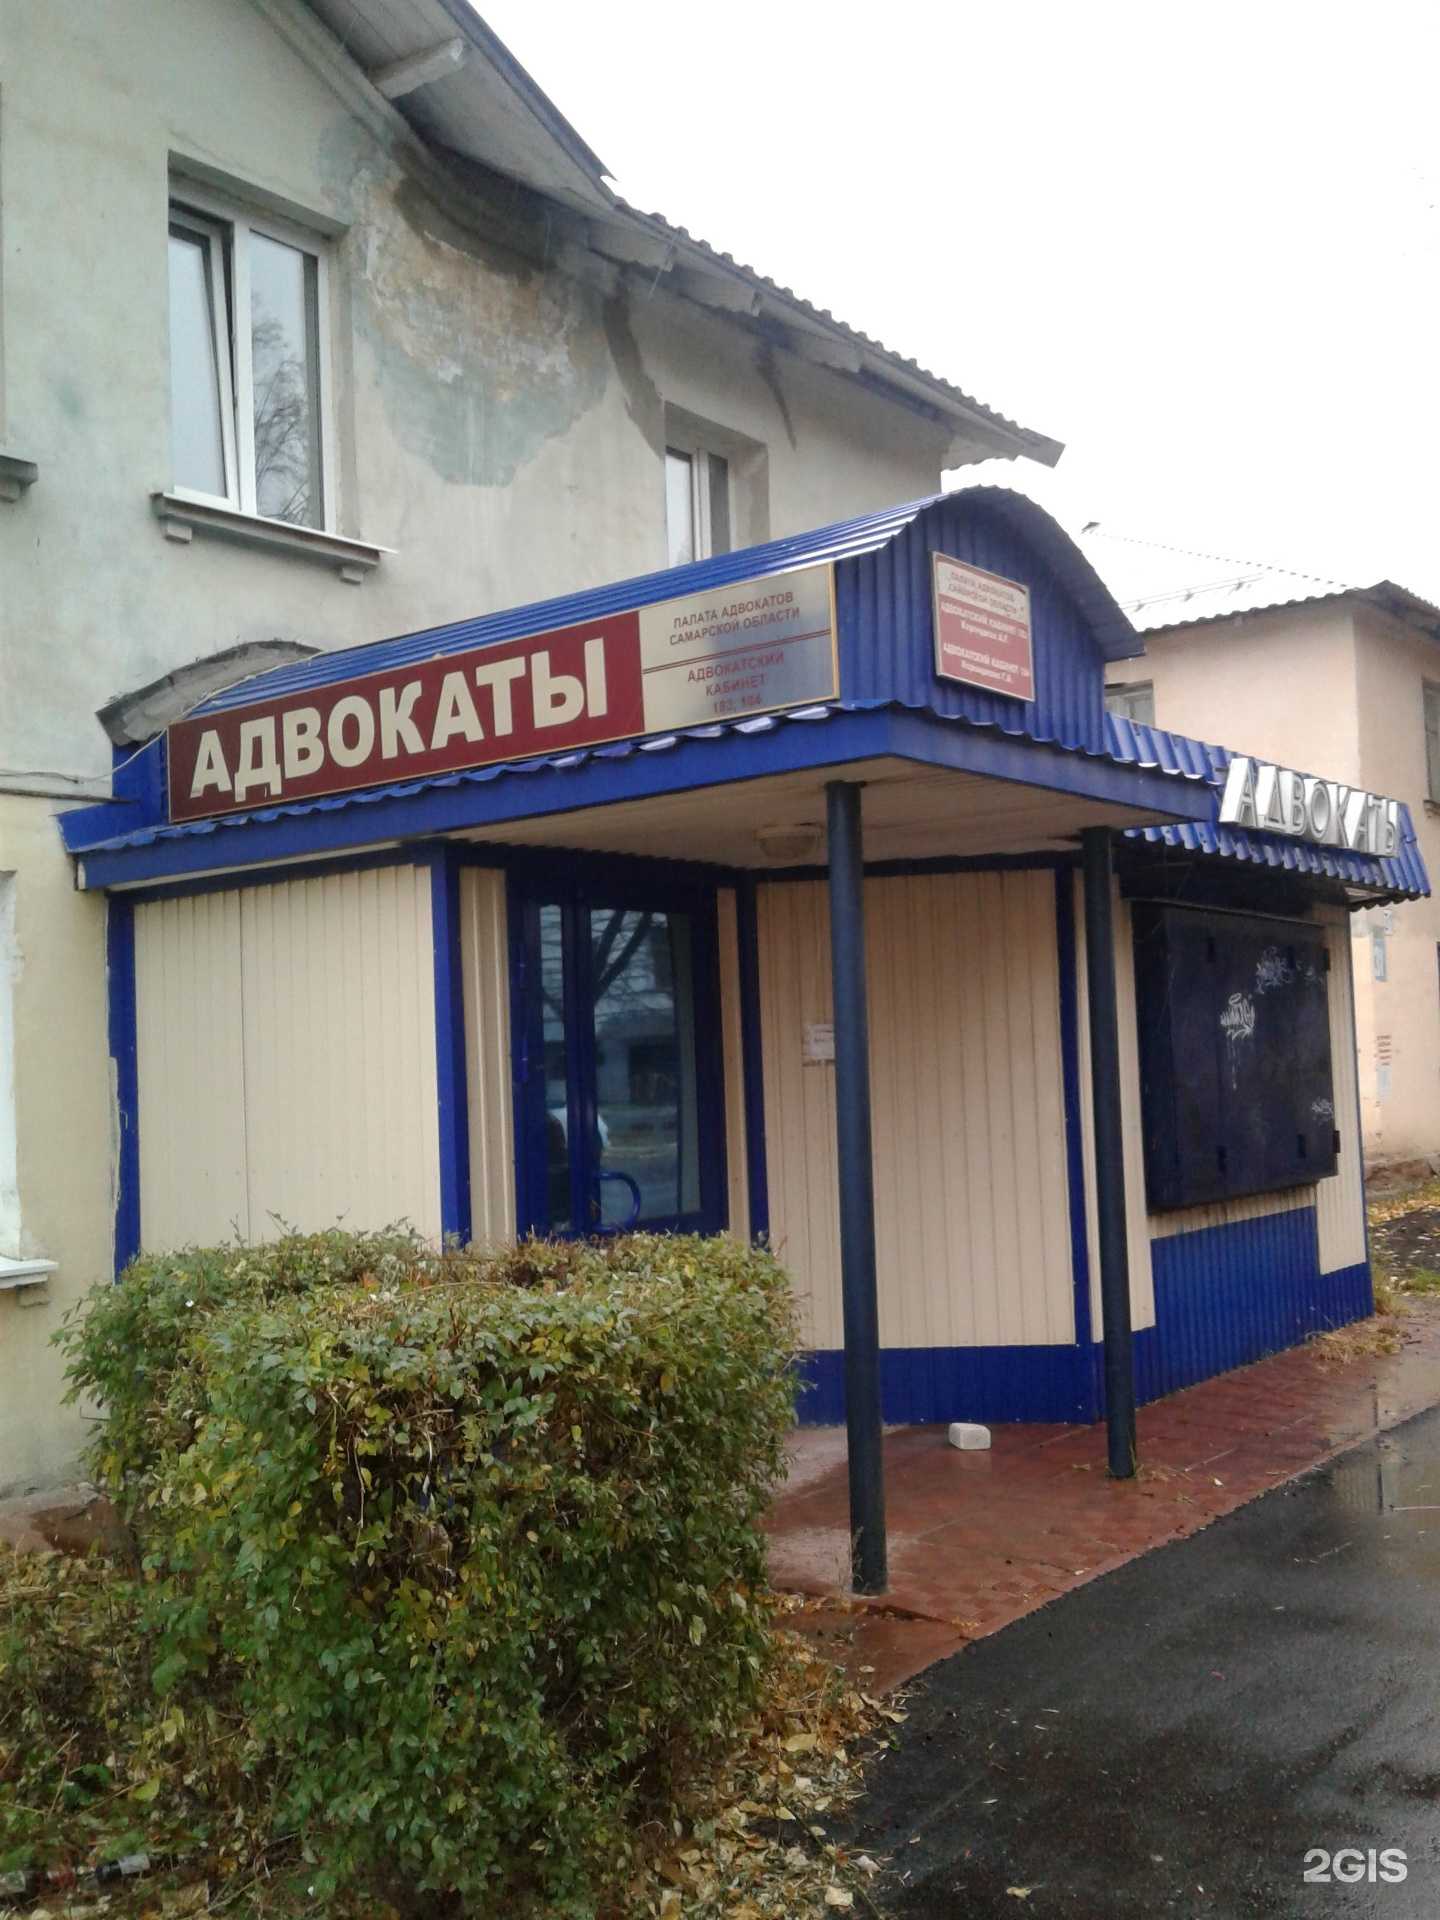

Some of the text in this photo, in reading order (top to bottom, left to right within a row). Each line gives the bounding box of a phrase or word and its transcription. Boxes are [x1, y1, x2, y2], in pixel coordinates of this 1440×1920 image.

[669, 607, 801, 646] САМАРСКОЙ ОБЛАСТИ
[673, 591, 794, 628] ПАЛАТА АДВОКАТОВ
[687, 652, 784, 682] АДВОКАТСКИЙ
[705, 673, 767, 697] КАБИНЕТ
[190, 637, 607, 802] АДВОКАТЫ
[1219, 757, 1400, 859] АДВОКАТЫ
